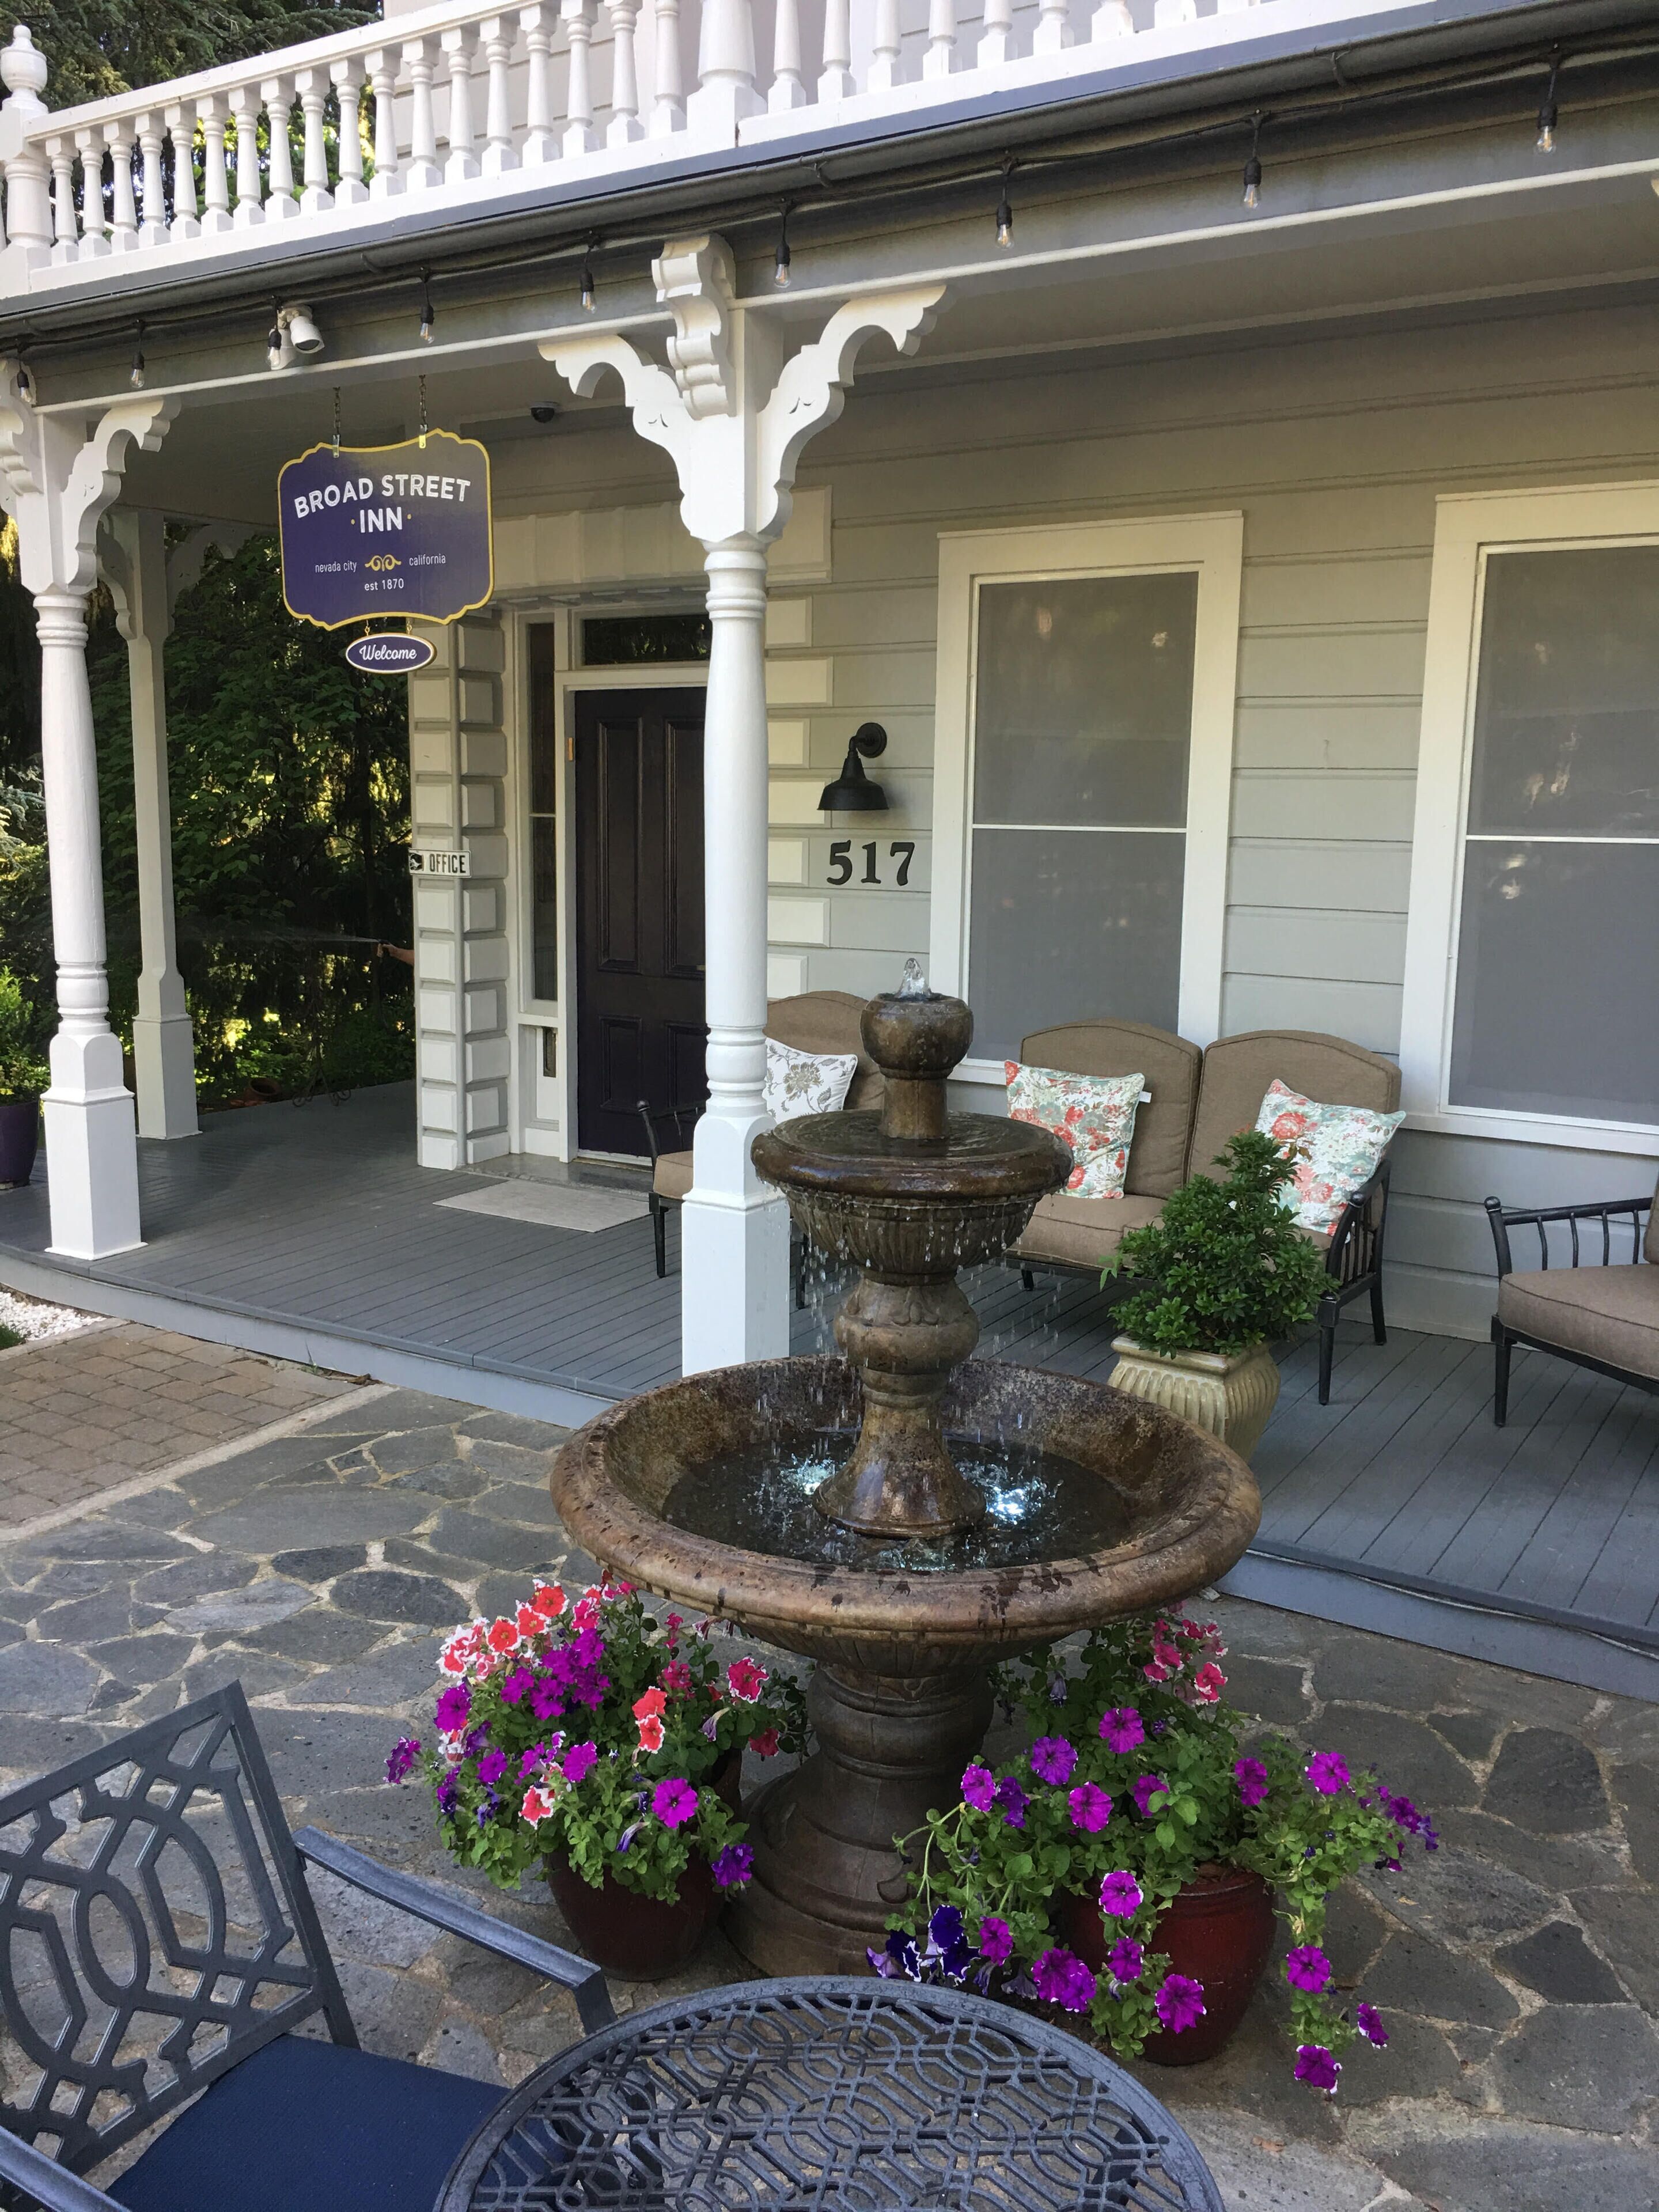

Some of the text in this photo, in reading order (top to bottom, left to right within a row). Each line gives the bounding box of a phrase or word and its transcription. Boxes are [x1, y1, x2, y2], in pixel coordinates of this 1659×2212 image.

[294, 474, 471, 518] BROAD STREET
[359, 507, 403, 533] INN
[315, 560, 357, 573] nevada city
[409, 554, 446, 566] california
[364, 578, 404, 591] est 1870
[359, 645, 417, 661] Welcome
[429, 854, 466, 874] OFFICE
[827, 839, 915, 887] 517
